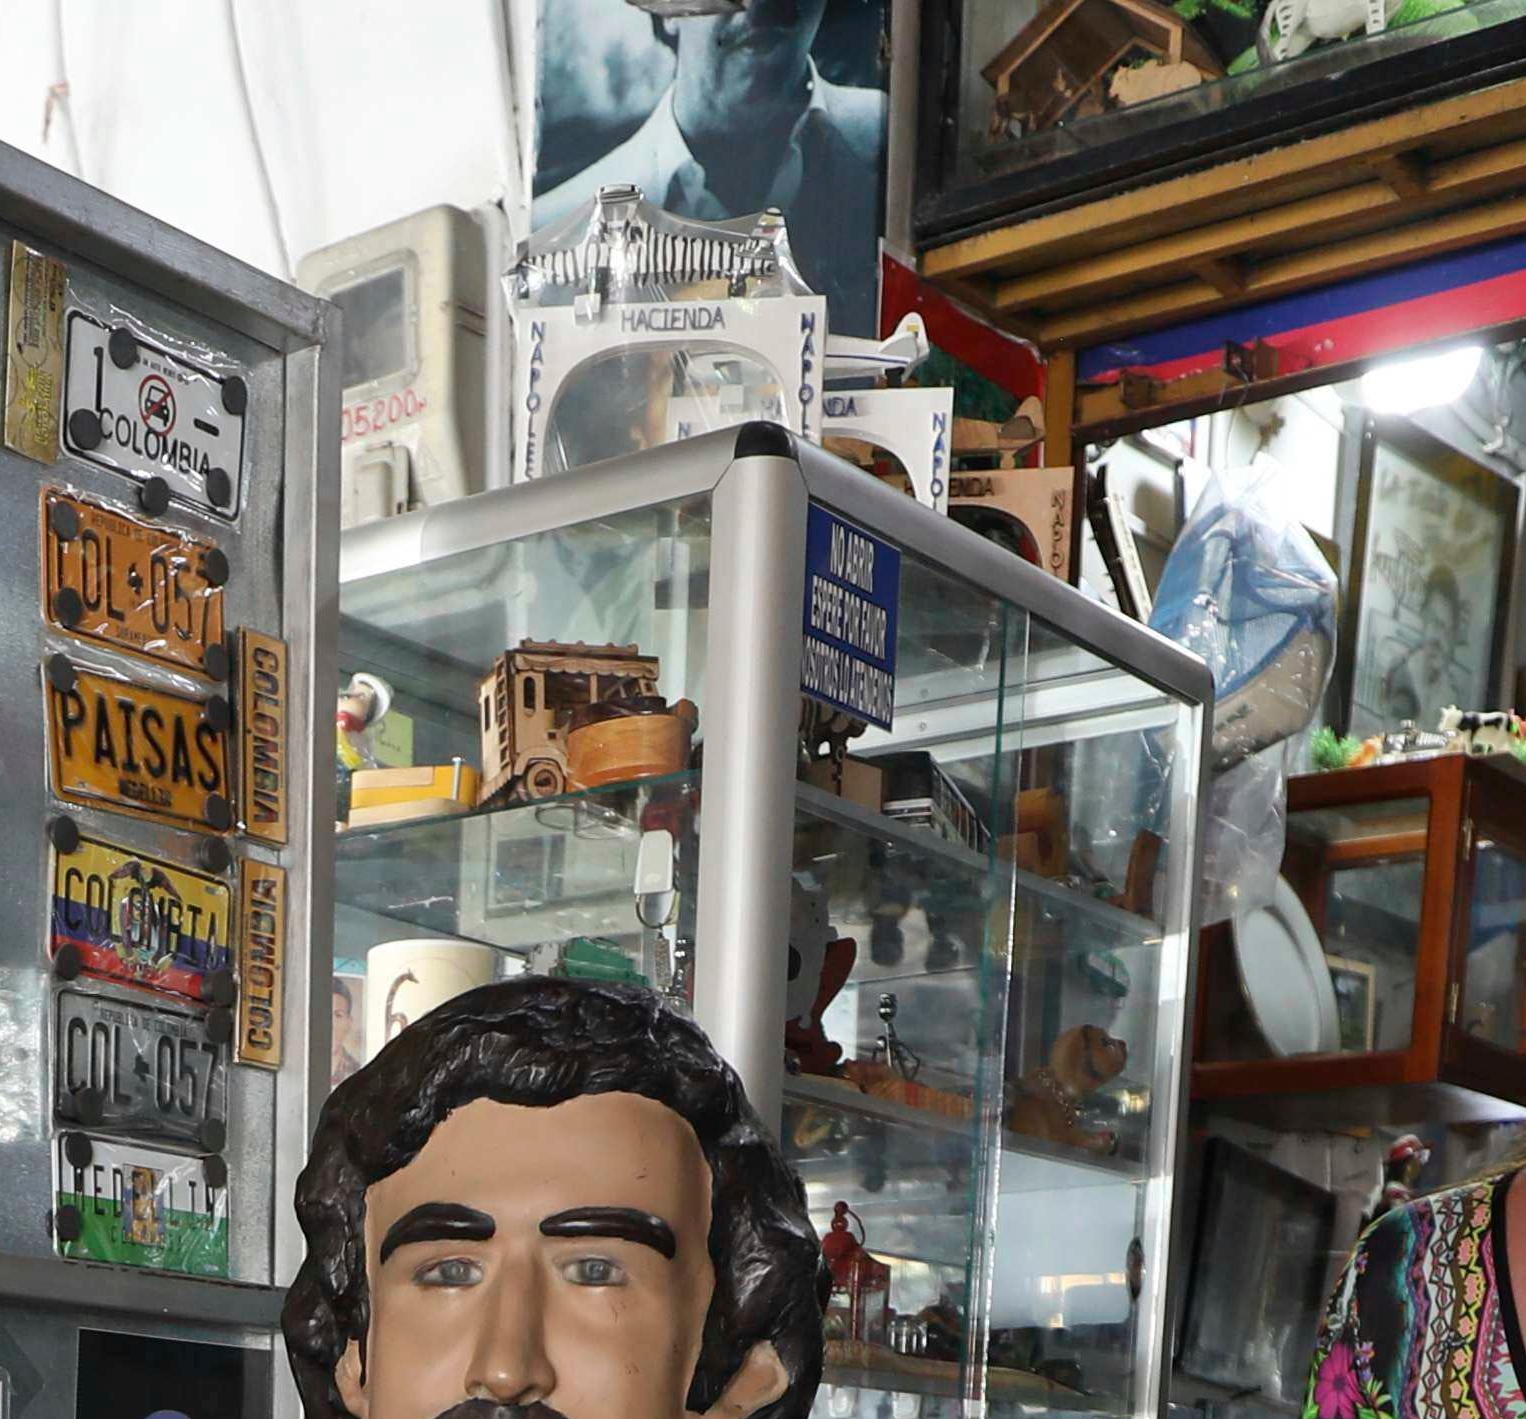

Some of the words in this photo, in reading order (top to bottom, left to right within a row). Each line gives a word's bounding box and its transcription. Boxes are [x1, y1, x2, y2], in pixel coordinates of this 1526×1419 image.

[620, 307, 726, 332] HACIENDA
[99, 409, 211, 476] COLOMBIA
[830, 522, 845, 577] NO
[846, 532, 874, 593] ABRIR
[59, 688, 221, 792] PAISAS
[251, 646, 280, 824] COLOMBIA
[247, 879, 278, 1051] COLOMBIA
